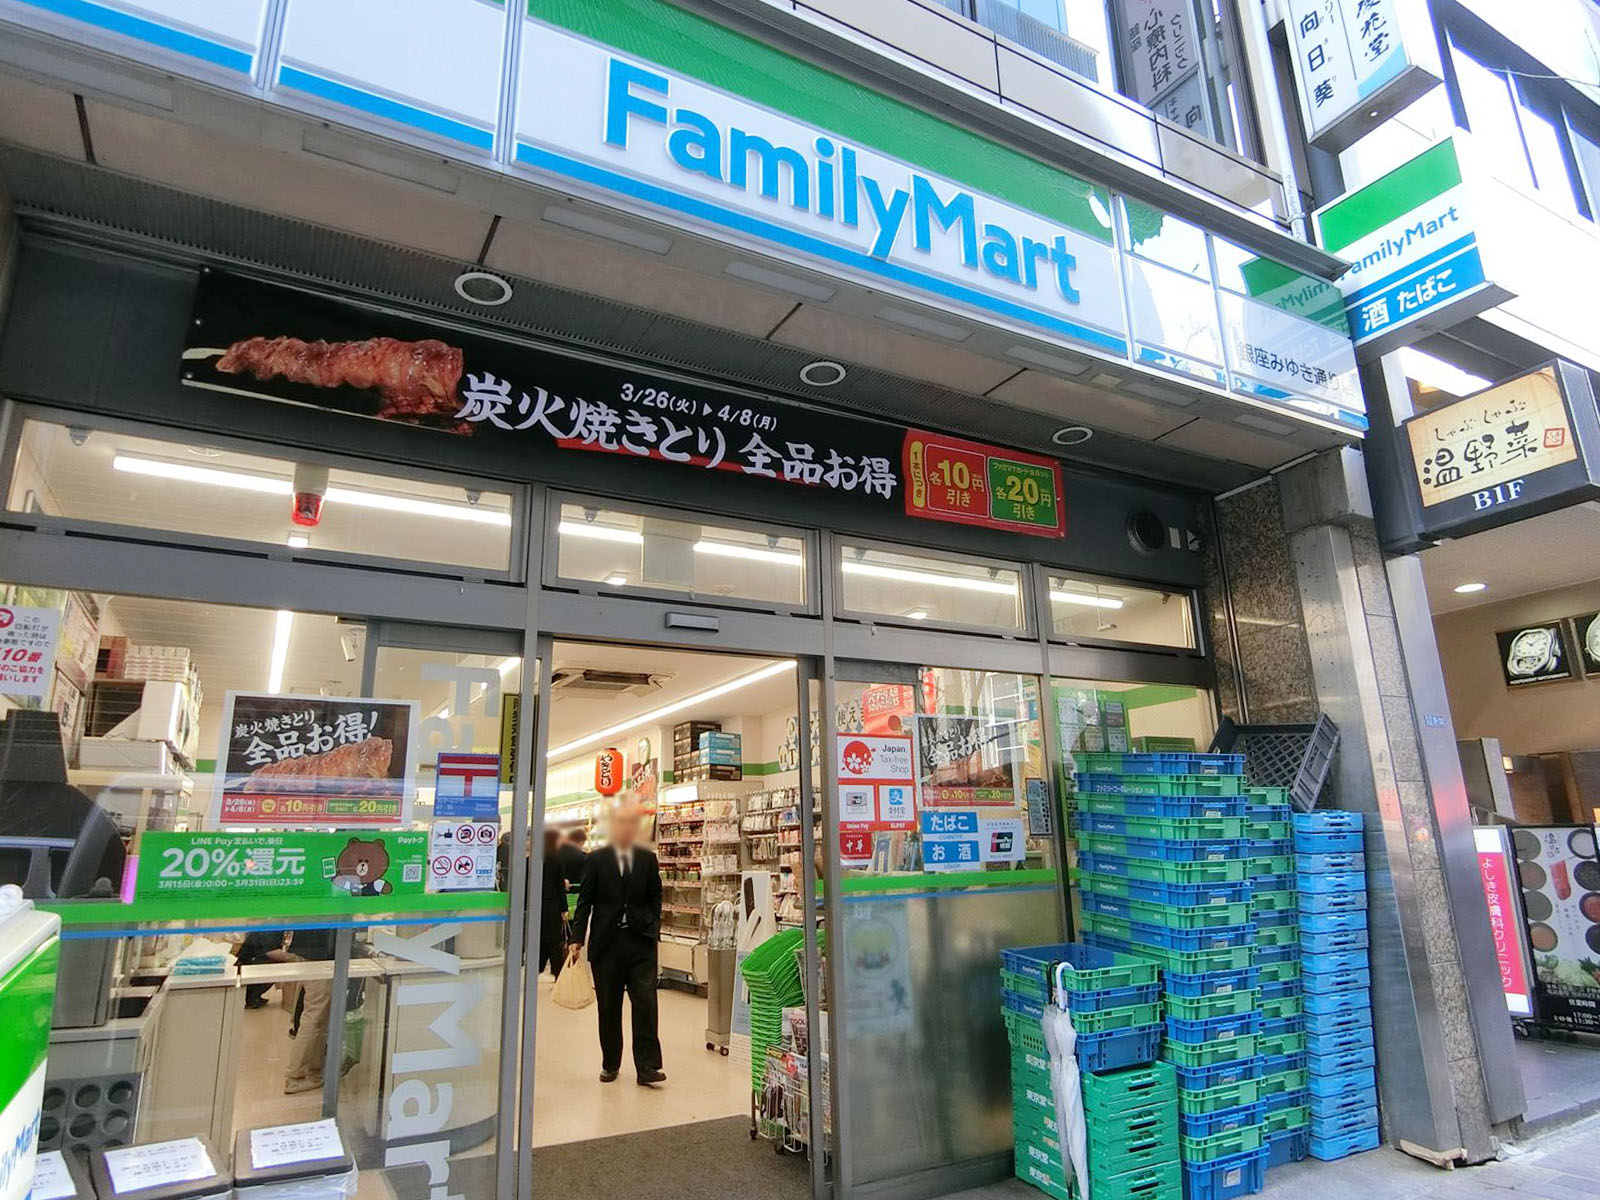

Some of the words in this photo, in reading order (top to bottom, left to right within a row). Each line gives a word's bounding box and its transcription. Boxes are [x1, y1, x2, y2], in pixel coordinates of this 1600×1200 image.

[1300, 10, 1334, 108] 向日葵
[604, 57, 1081, 304] FamilyMart
[1341, 206, 1459, 281] amilyMart
[1361, 296, 1390, 332] 酒
[1396, 269, 1457, 313] たばこ
[620, 382, 697, 415] 3/26(火)
[717, 404, 777, 432] 4/8(月)
[453, 371, 727, 469] 炭火焼きとり
[738, 431, 898, 500] 全品お得
[1423, 420, 1538, 488] 温野菜
[945, 488, 972, 507] 引き
[1472, 479, 1526, 511] B1F
[1012, 502, 1036, 520] 引き
[0, 647, 43, 662] 10番
[234, 709, 315, 739] 炭火焼きとり
[882, 744, 906, 754] Japan
[890, 764, 910, 775] Shop
[930, 814, 969, 831] たばこ
[191, 837, 213, 846] LINE
[160, 847, 307, 878] 20%還元
